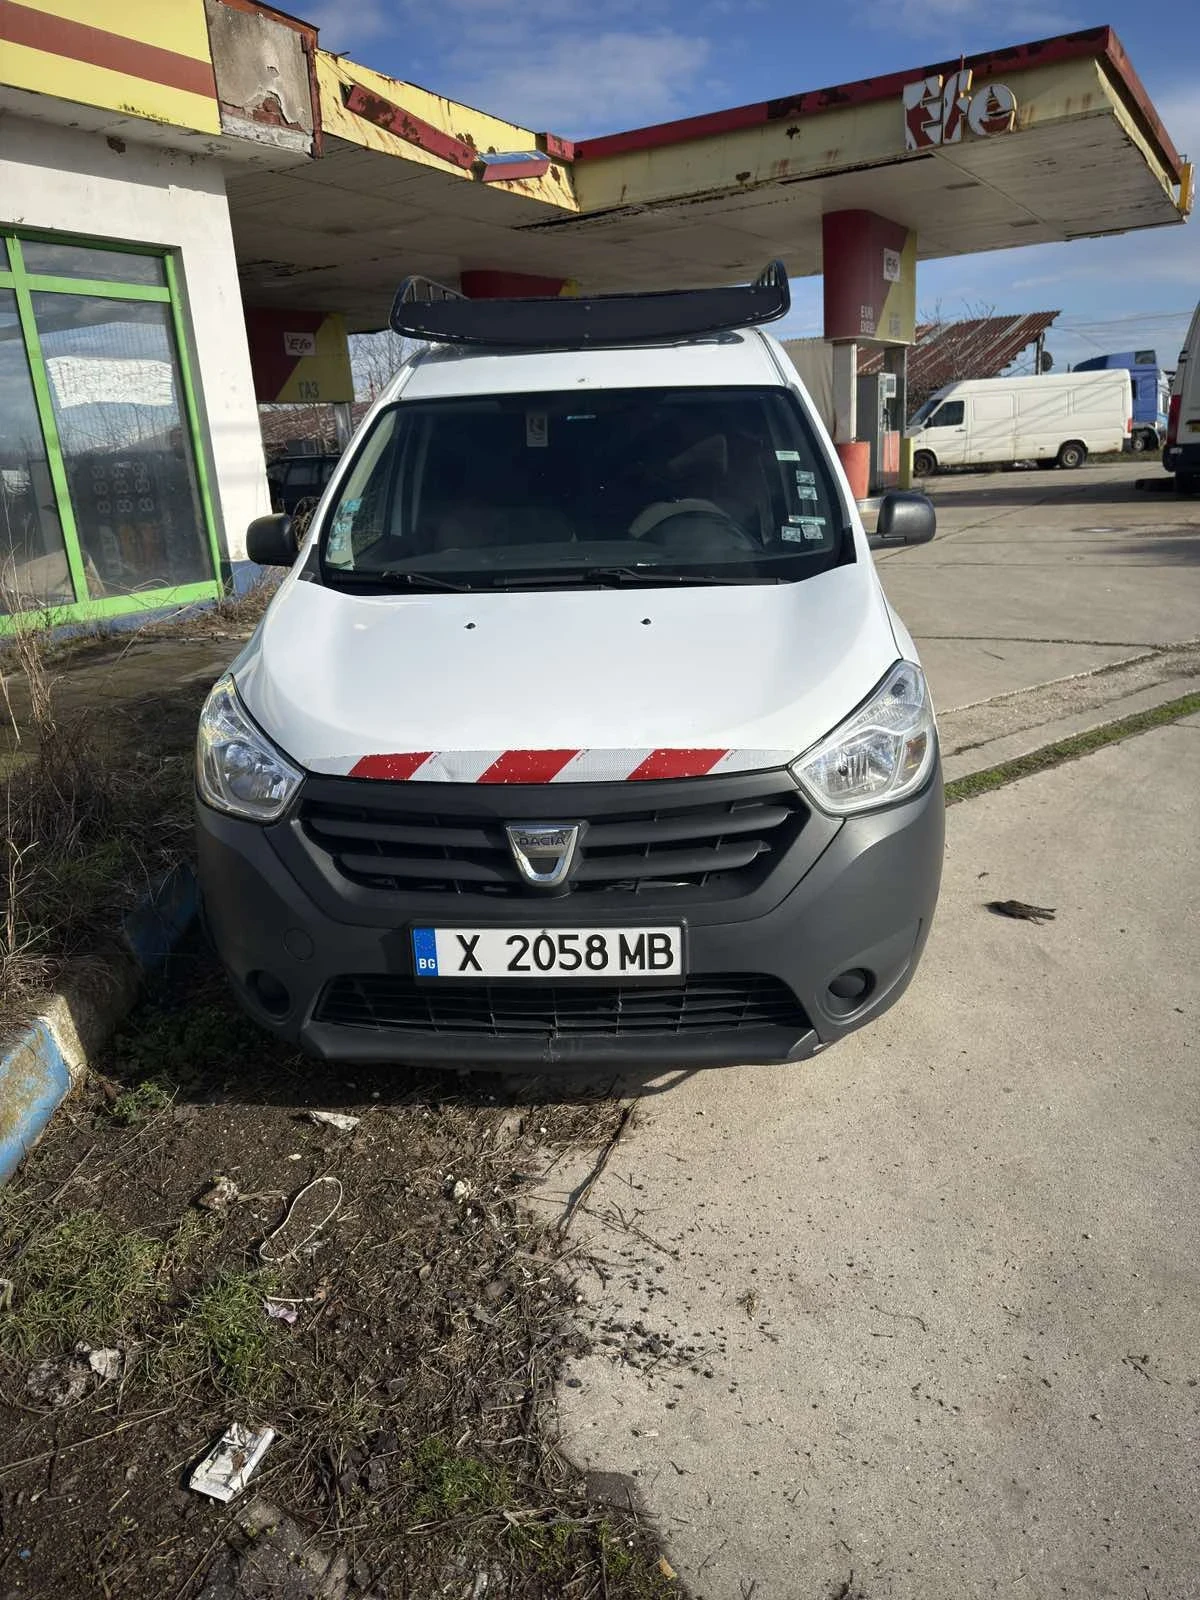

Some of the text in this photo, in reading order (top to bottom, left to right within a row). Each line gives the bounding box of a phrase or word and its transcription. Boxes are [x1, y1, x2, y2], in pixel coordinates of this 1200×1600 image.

[520, 836, 566, 846] DACIA
[456, 932, 674, 972] X 2058 MB
[419, 958, 436, 969] BG
